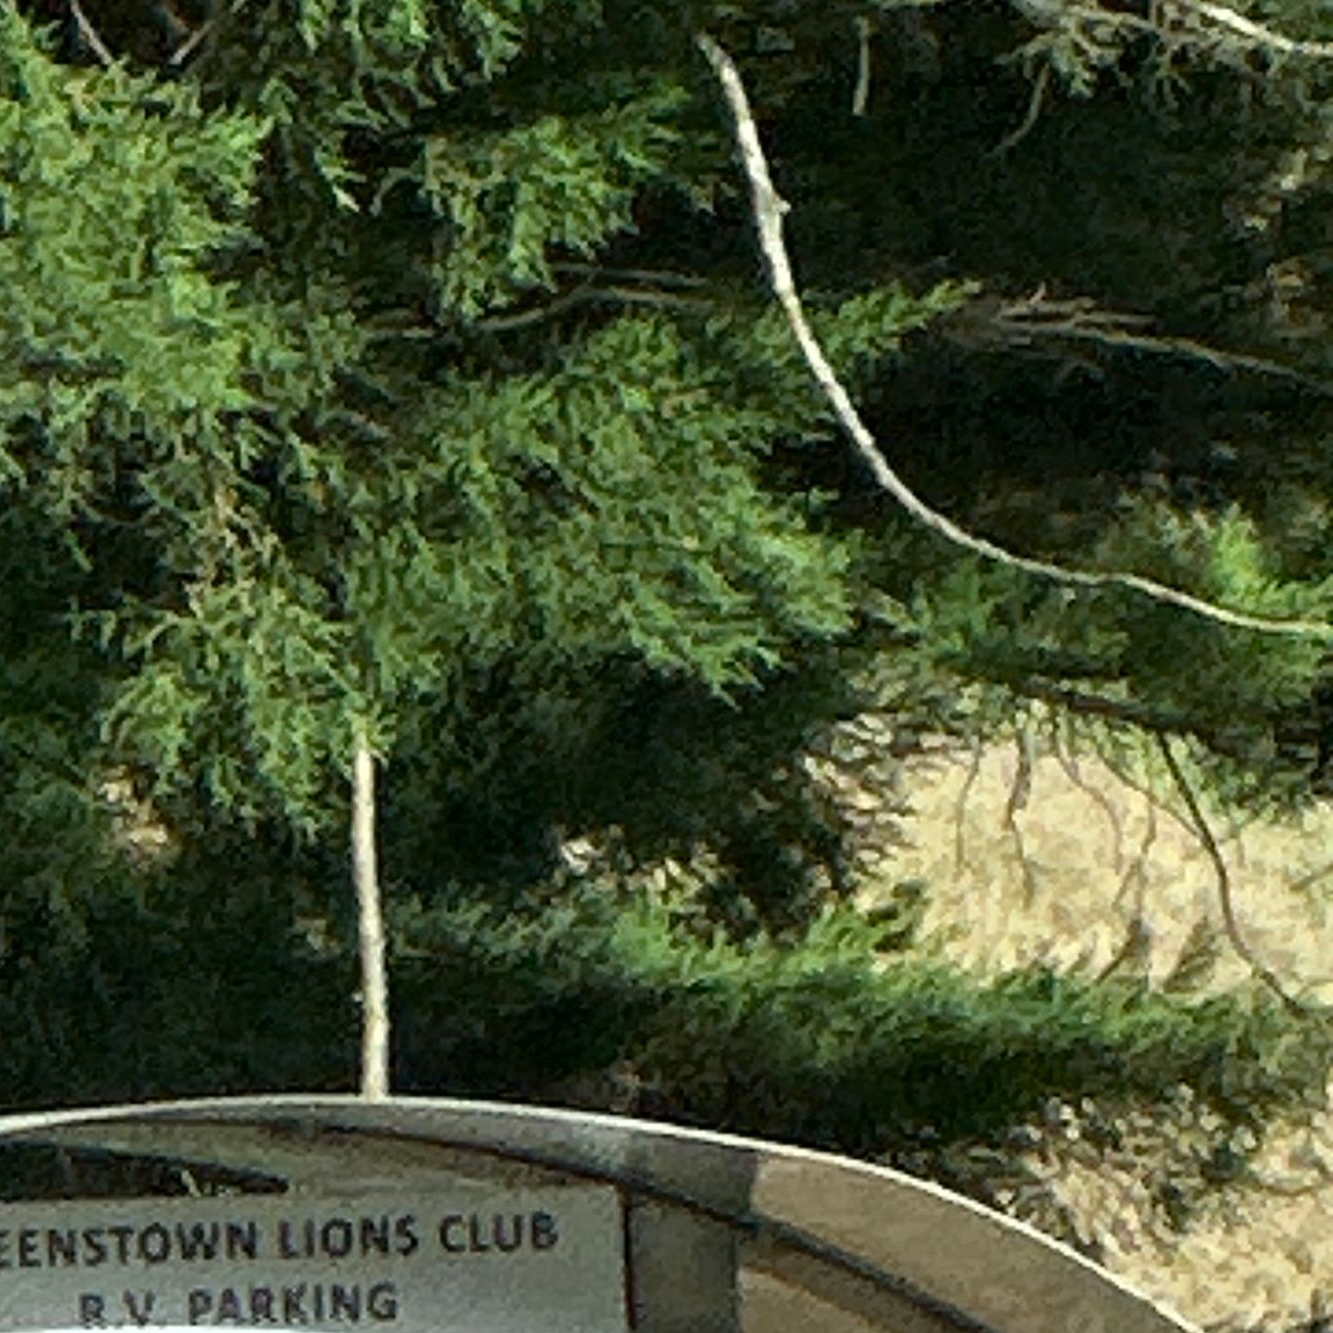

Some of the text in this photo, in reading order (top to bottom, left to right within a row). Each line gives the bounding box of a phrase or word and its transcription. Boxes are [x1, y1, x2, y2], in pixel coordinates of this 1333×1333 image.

[279, 1215, 419, 1260] LIONS
[440, 1211, 559, 1254] CLUB
[188, 1281, 398, 1327] PARKING
